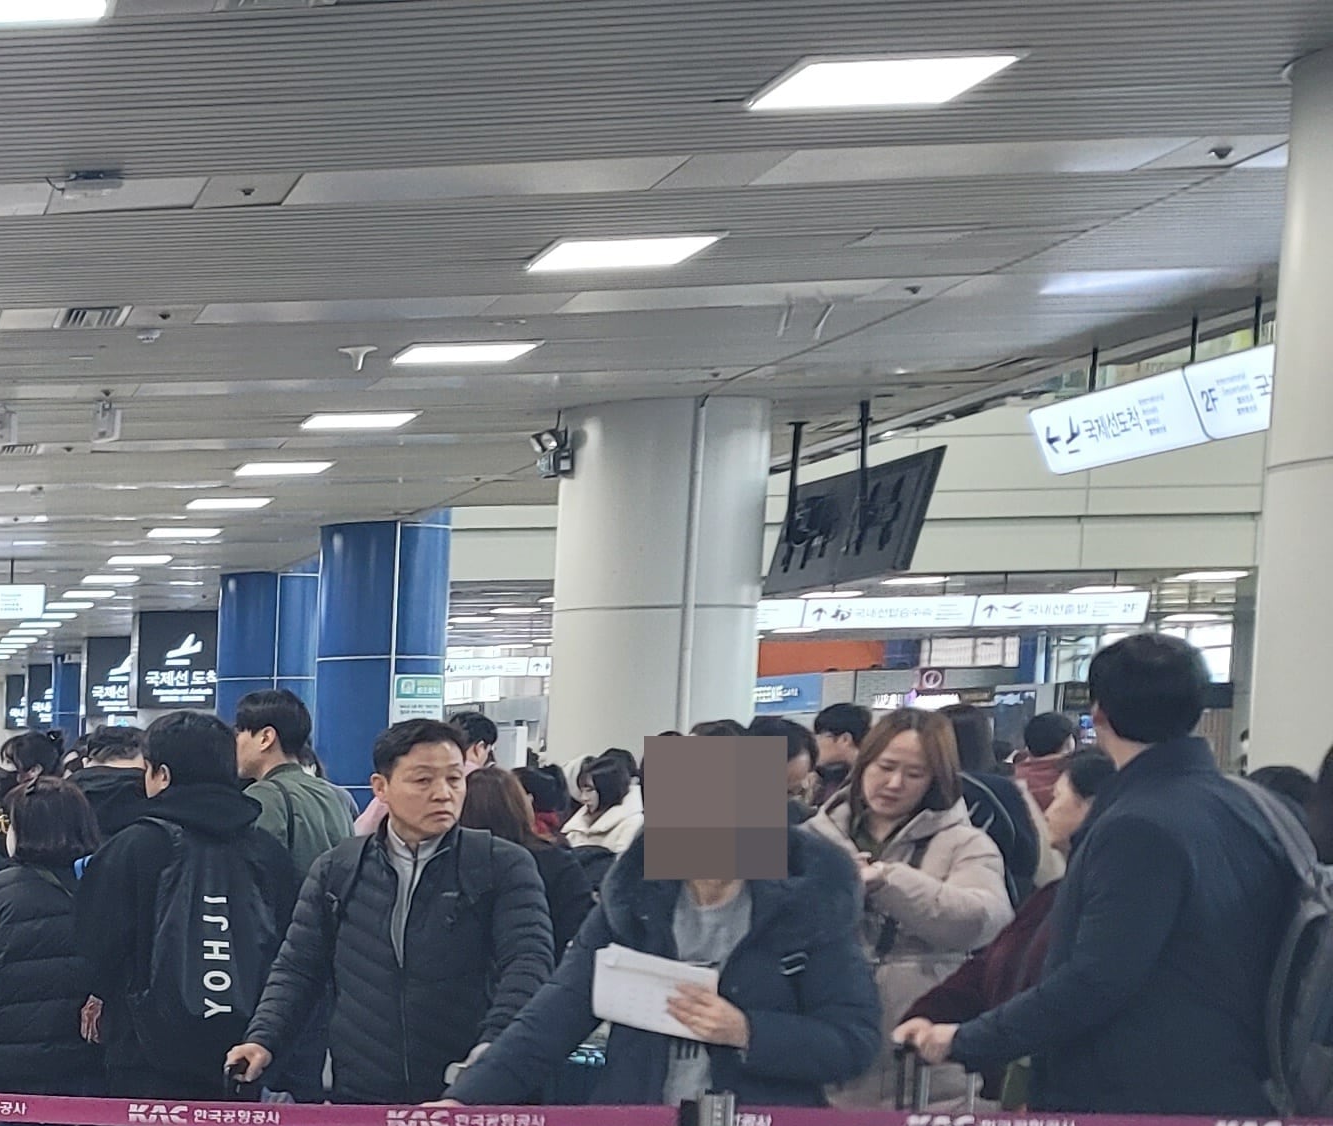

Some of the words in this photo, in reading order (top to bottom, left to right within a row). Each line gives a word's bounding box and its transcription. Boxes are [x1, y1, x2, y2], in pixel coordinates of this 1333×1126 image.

[1200, 387, 1219, 414] 2F
[1082, 407, 1144, 443] 국제선도착
[145, 669, 189, 687] 국제선
[202, 895, 232, 1019] YOHJI
[128, 1103, 189, 1125] KAC
[194, 1108, 281, 1126] 한국공항공사
